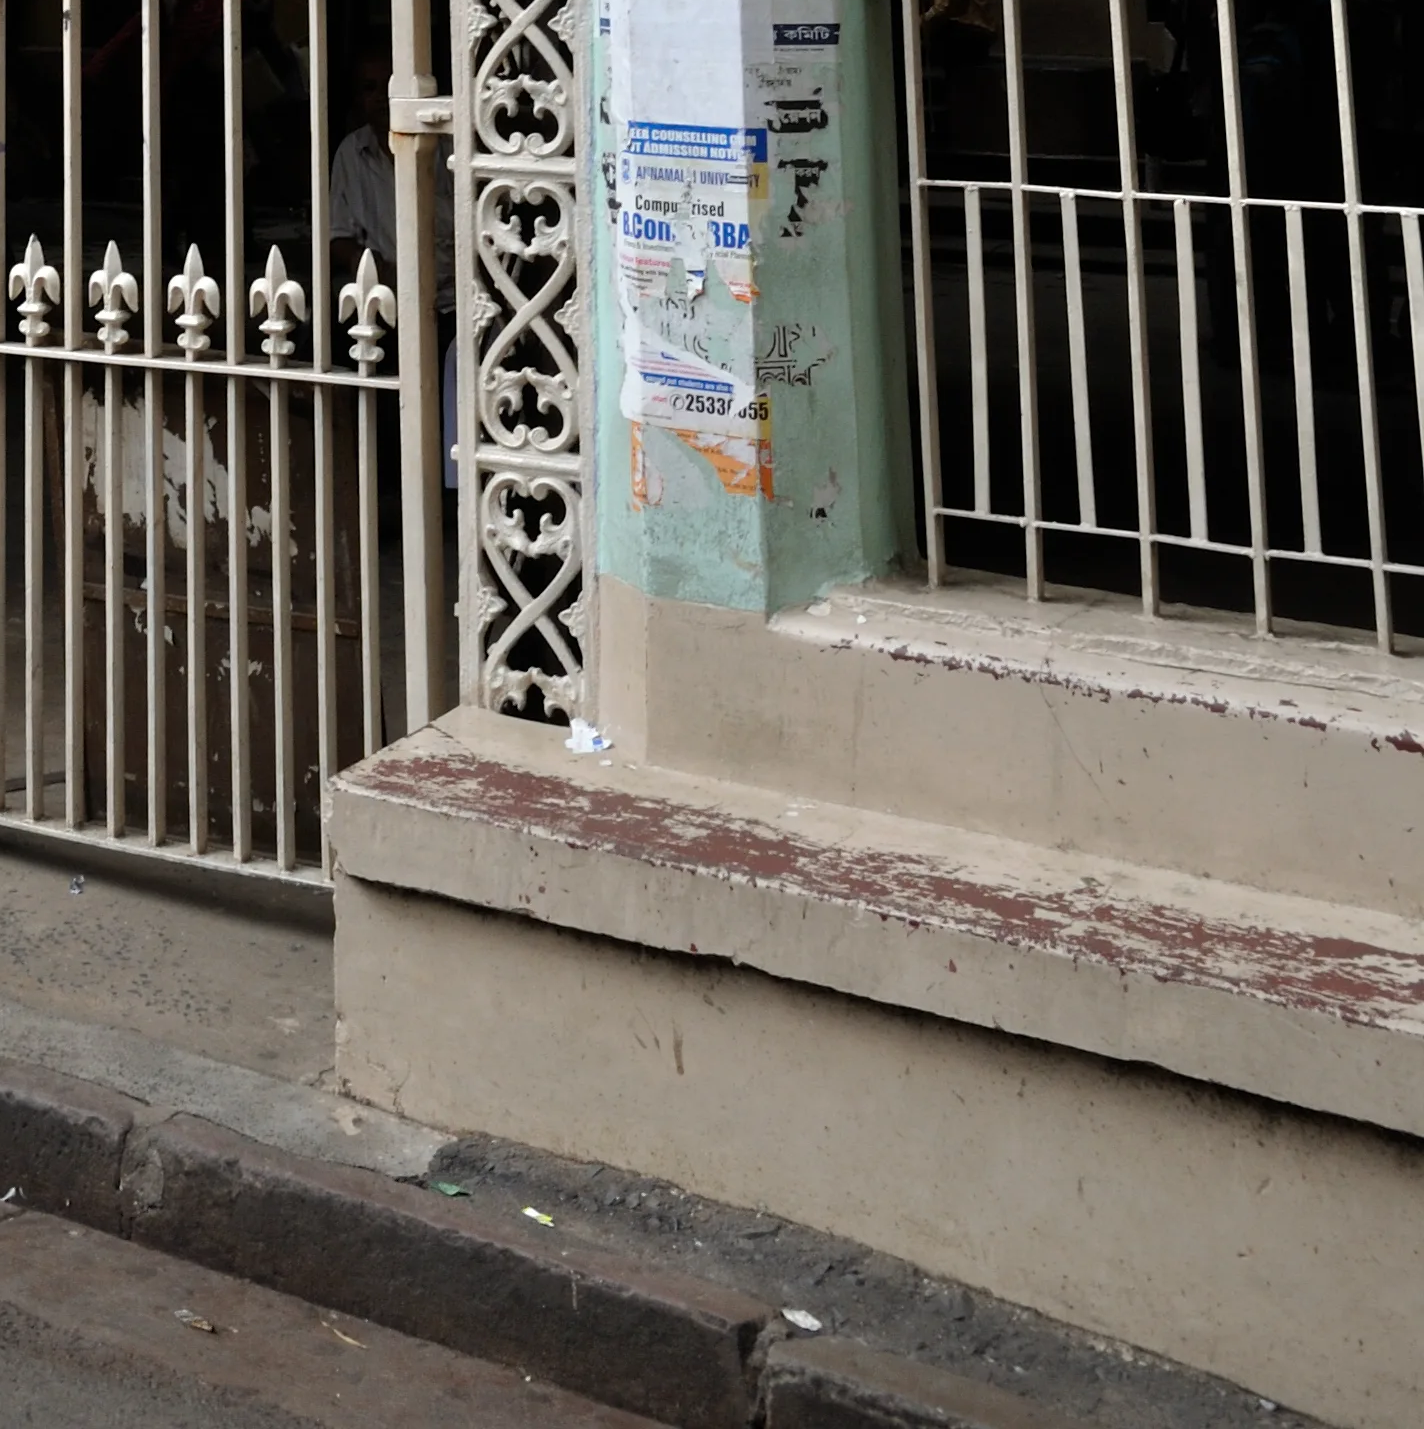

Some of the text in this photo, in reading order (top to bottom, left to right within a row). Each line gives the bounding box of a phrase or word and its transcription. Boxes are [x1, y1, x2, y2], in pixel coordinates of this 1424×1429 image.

[652, 128, 728, 146] COUNSELLING
[644, 142, 709, 158] ADMISSION
[635, 194, 725, 217] Compurised
[685, 393, 770, 421] 253355
